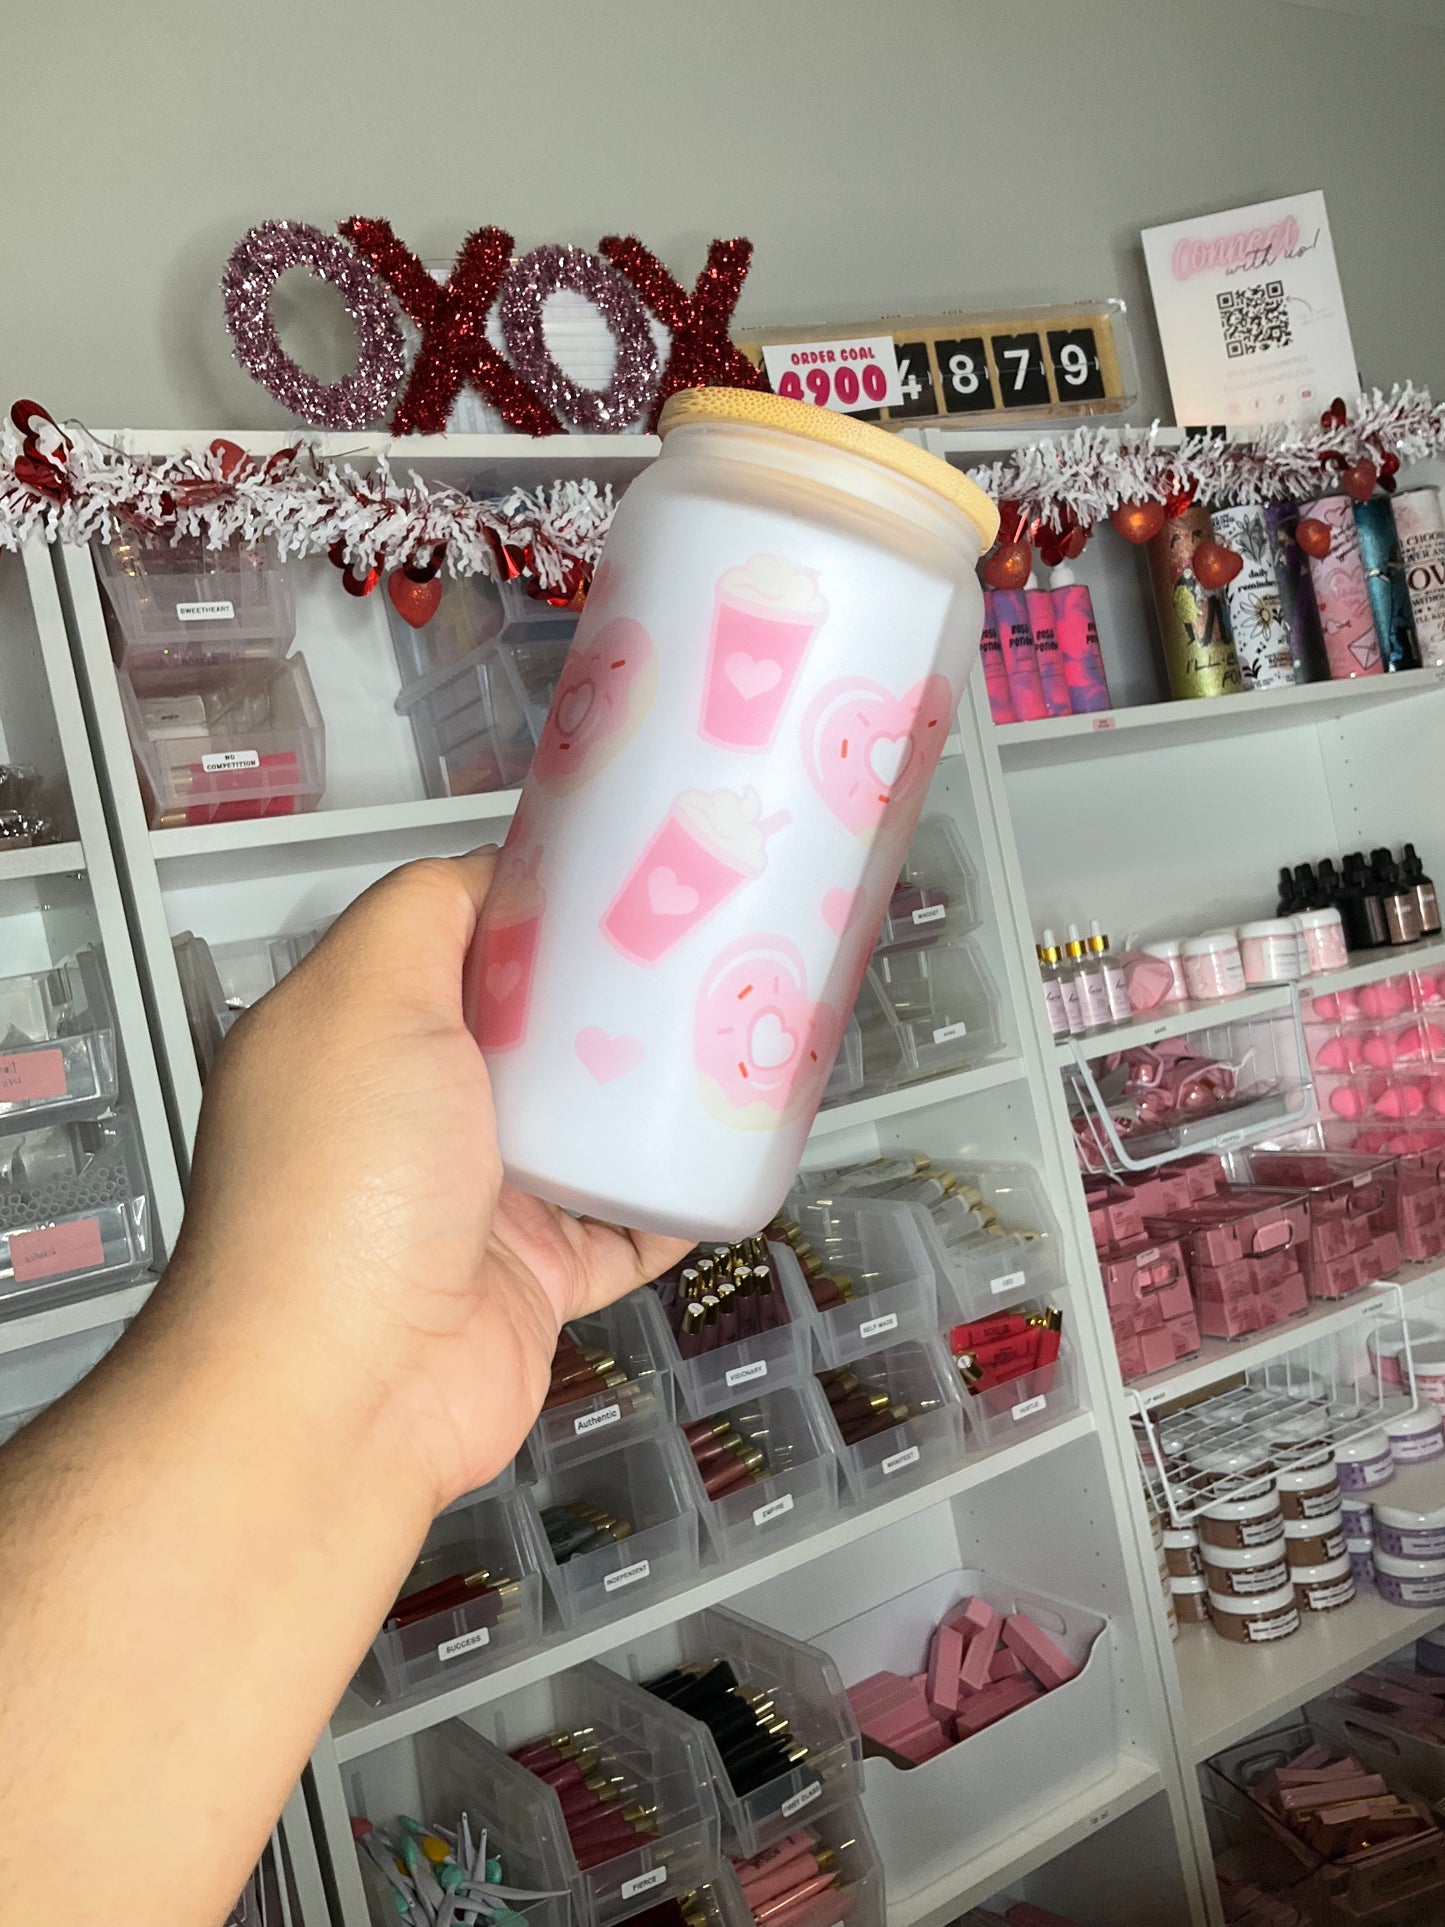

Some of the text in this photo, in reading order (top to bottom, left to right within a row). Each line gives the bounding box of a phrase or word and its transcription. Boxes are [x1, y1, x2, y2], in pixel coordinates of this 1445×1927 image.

[1172, 215, 1299, 281] Connect
[1225, 243, 1277, 276] with
[791, 346, 875, 366] ORDER GOAL
[778, 364, 887, 407] 4900
[1406, 530, 1445, 546] CHOO
[1248, 569, 1269, 579] daily
[1408, 564, 1445, 591] OV
[1237, 578, 1278, 593] reminde
[180, 605, 230, 615] SWEETHEART
[206, 760, 256, 771] COMPETITION
[730, 1365, 762, 1381] VISIONARY
[577, 1409, 617, 1430] Authentic
[887, 1451, 914, 1468] MANIFEST
[762, 1501, 785, 1518] EMPIRE
[606, 1564, 647, 1586] INDEPENDENT
[446, 1634, 482, 1654] SUCCESS
[632, 1875, 657, 1892] FIERCE
